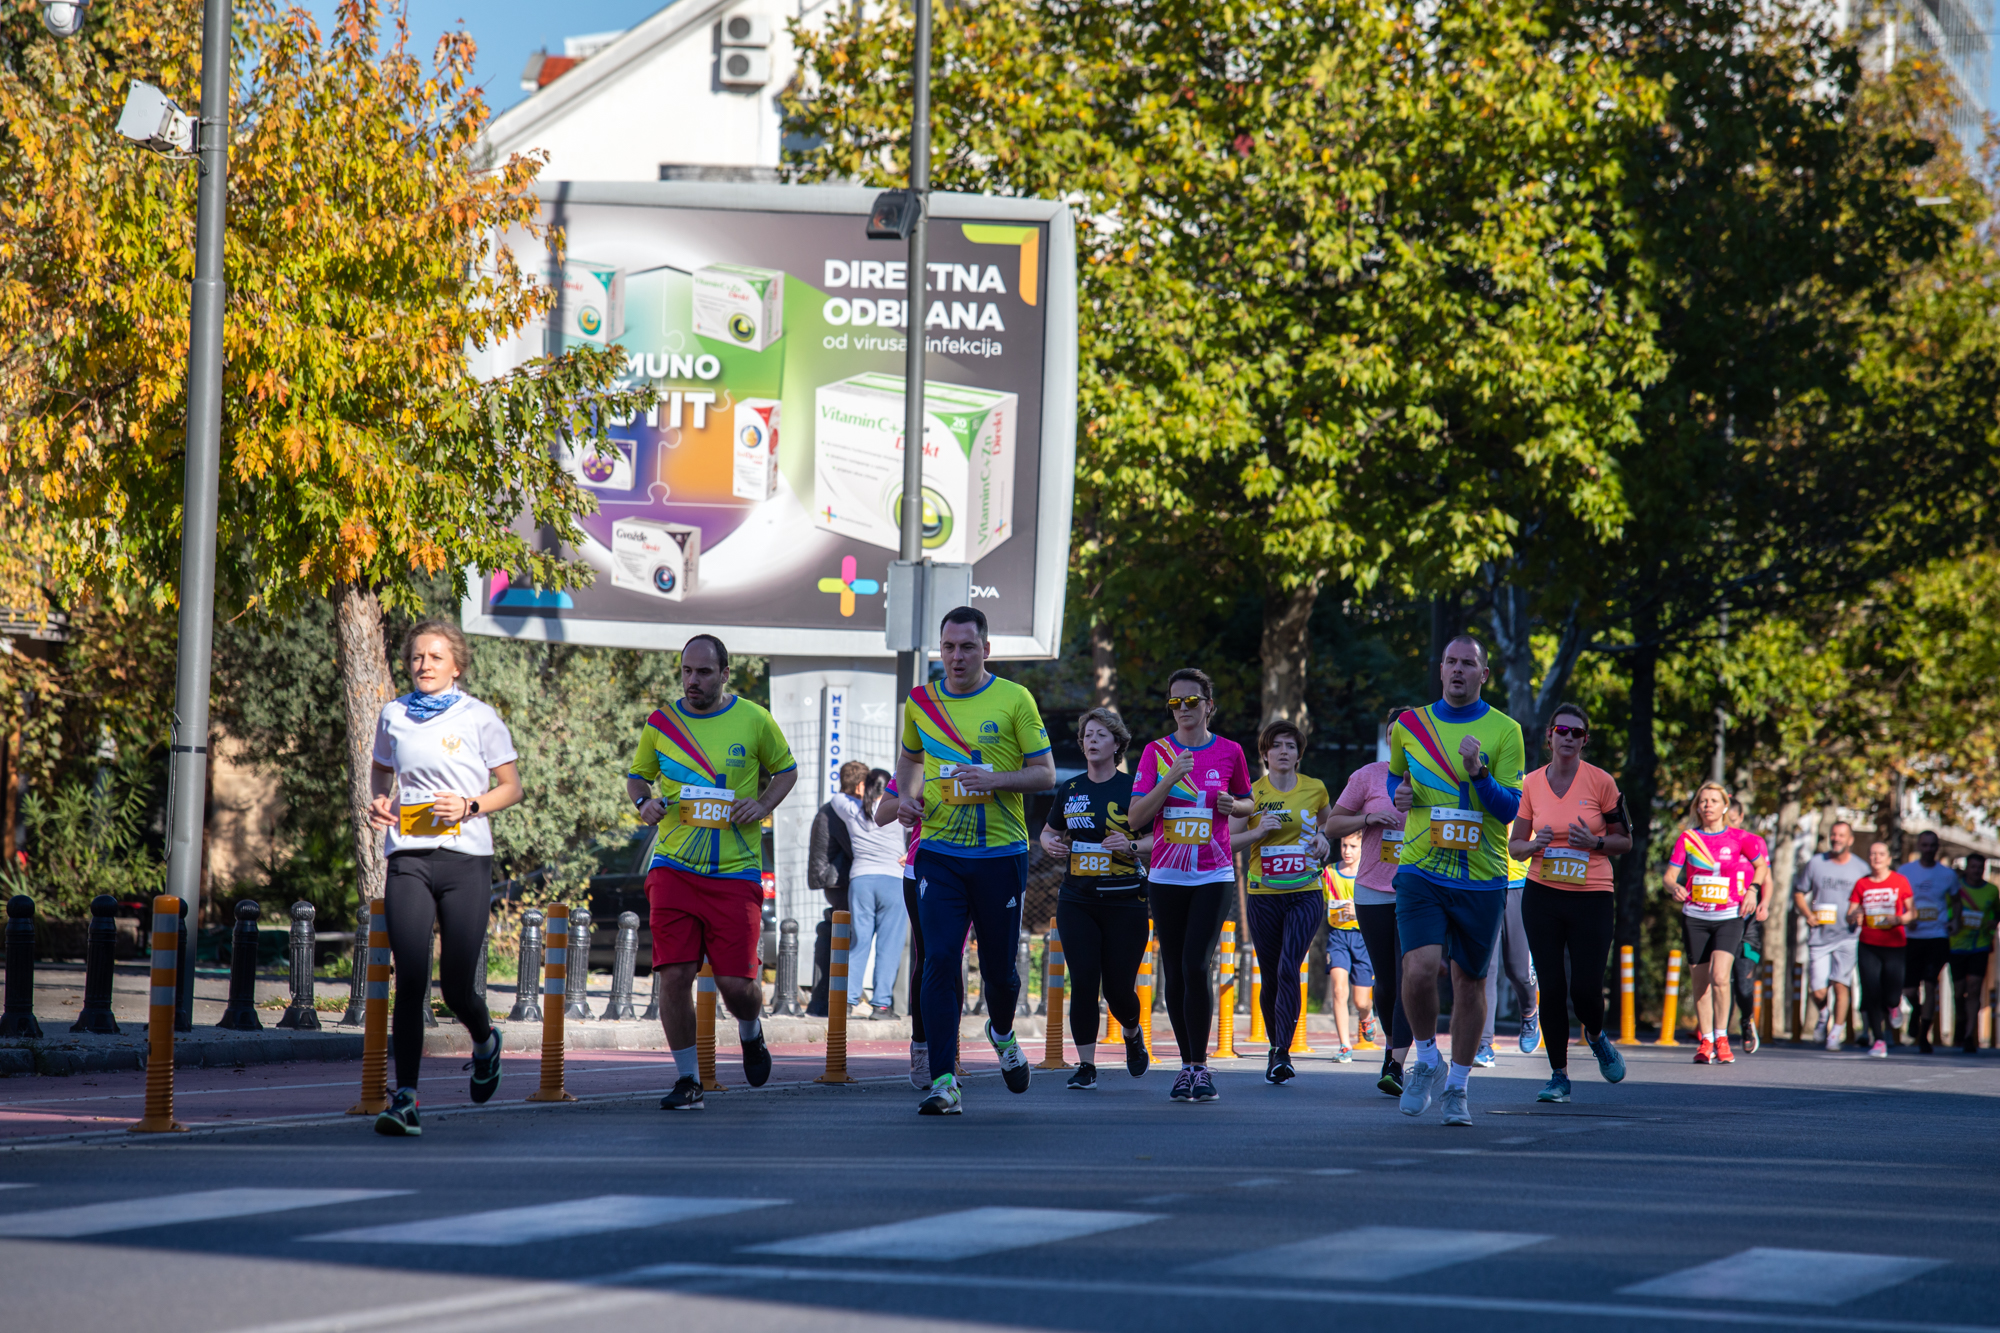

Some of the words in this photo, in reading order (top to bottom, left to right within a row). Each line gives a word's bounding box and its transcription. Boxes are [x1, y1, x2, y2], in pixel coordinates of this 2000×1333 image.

[823, 333, 848, 350] od
[925, 336, 1003, 359] infekcija
[615, 352, 721, 381] MUNO
[821, 405, 876, 430] Vitamin
[952, 415, 968, 429] 20
[692, 801, 732, 823] 1264
[1063, 801, 1092, 815] SANUS
[1174, 821, 1210, 838] 478
[1442, 823, 1480, 844] 616
[1079, 855, 1110, 871] 282
[1272, 857, 1305, 872] 275
[1552, 860, 1587, 879] 1172
[1701, 885, 1729, 900] 1210
